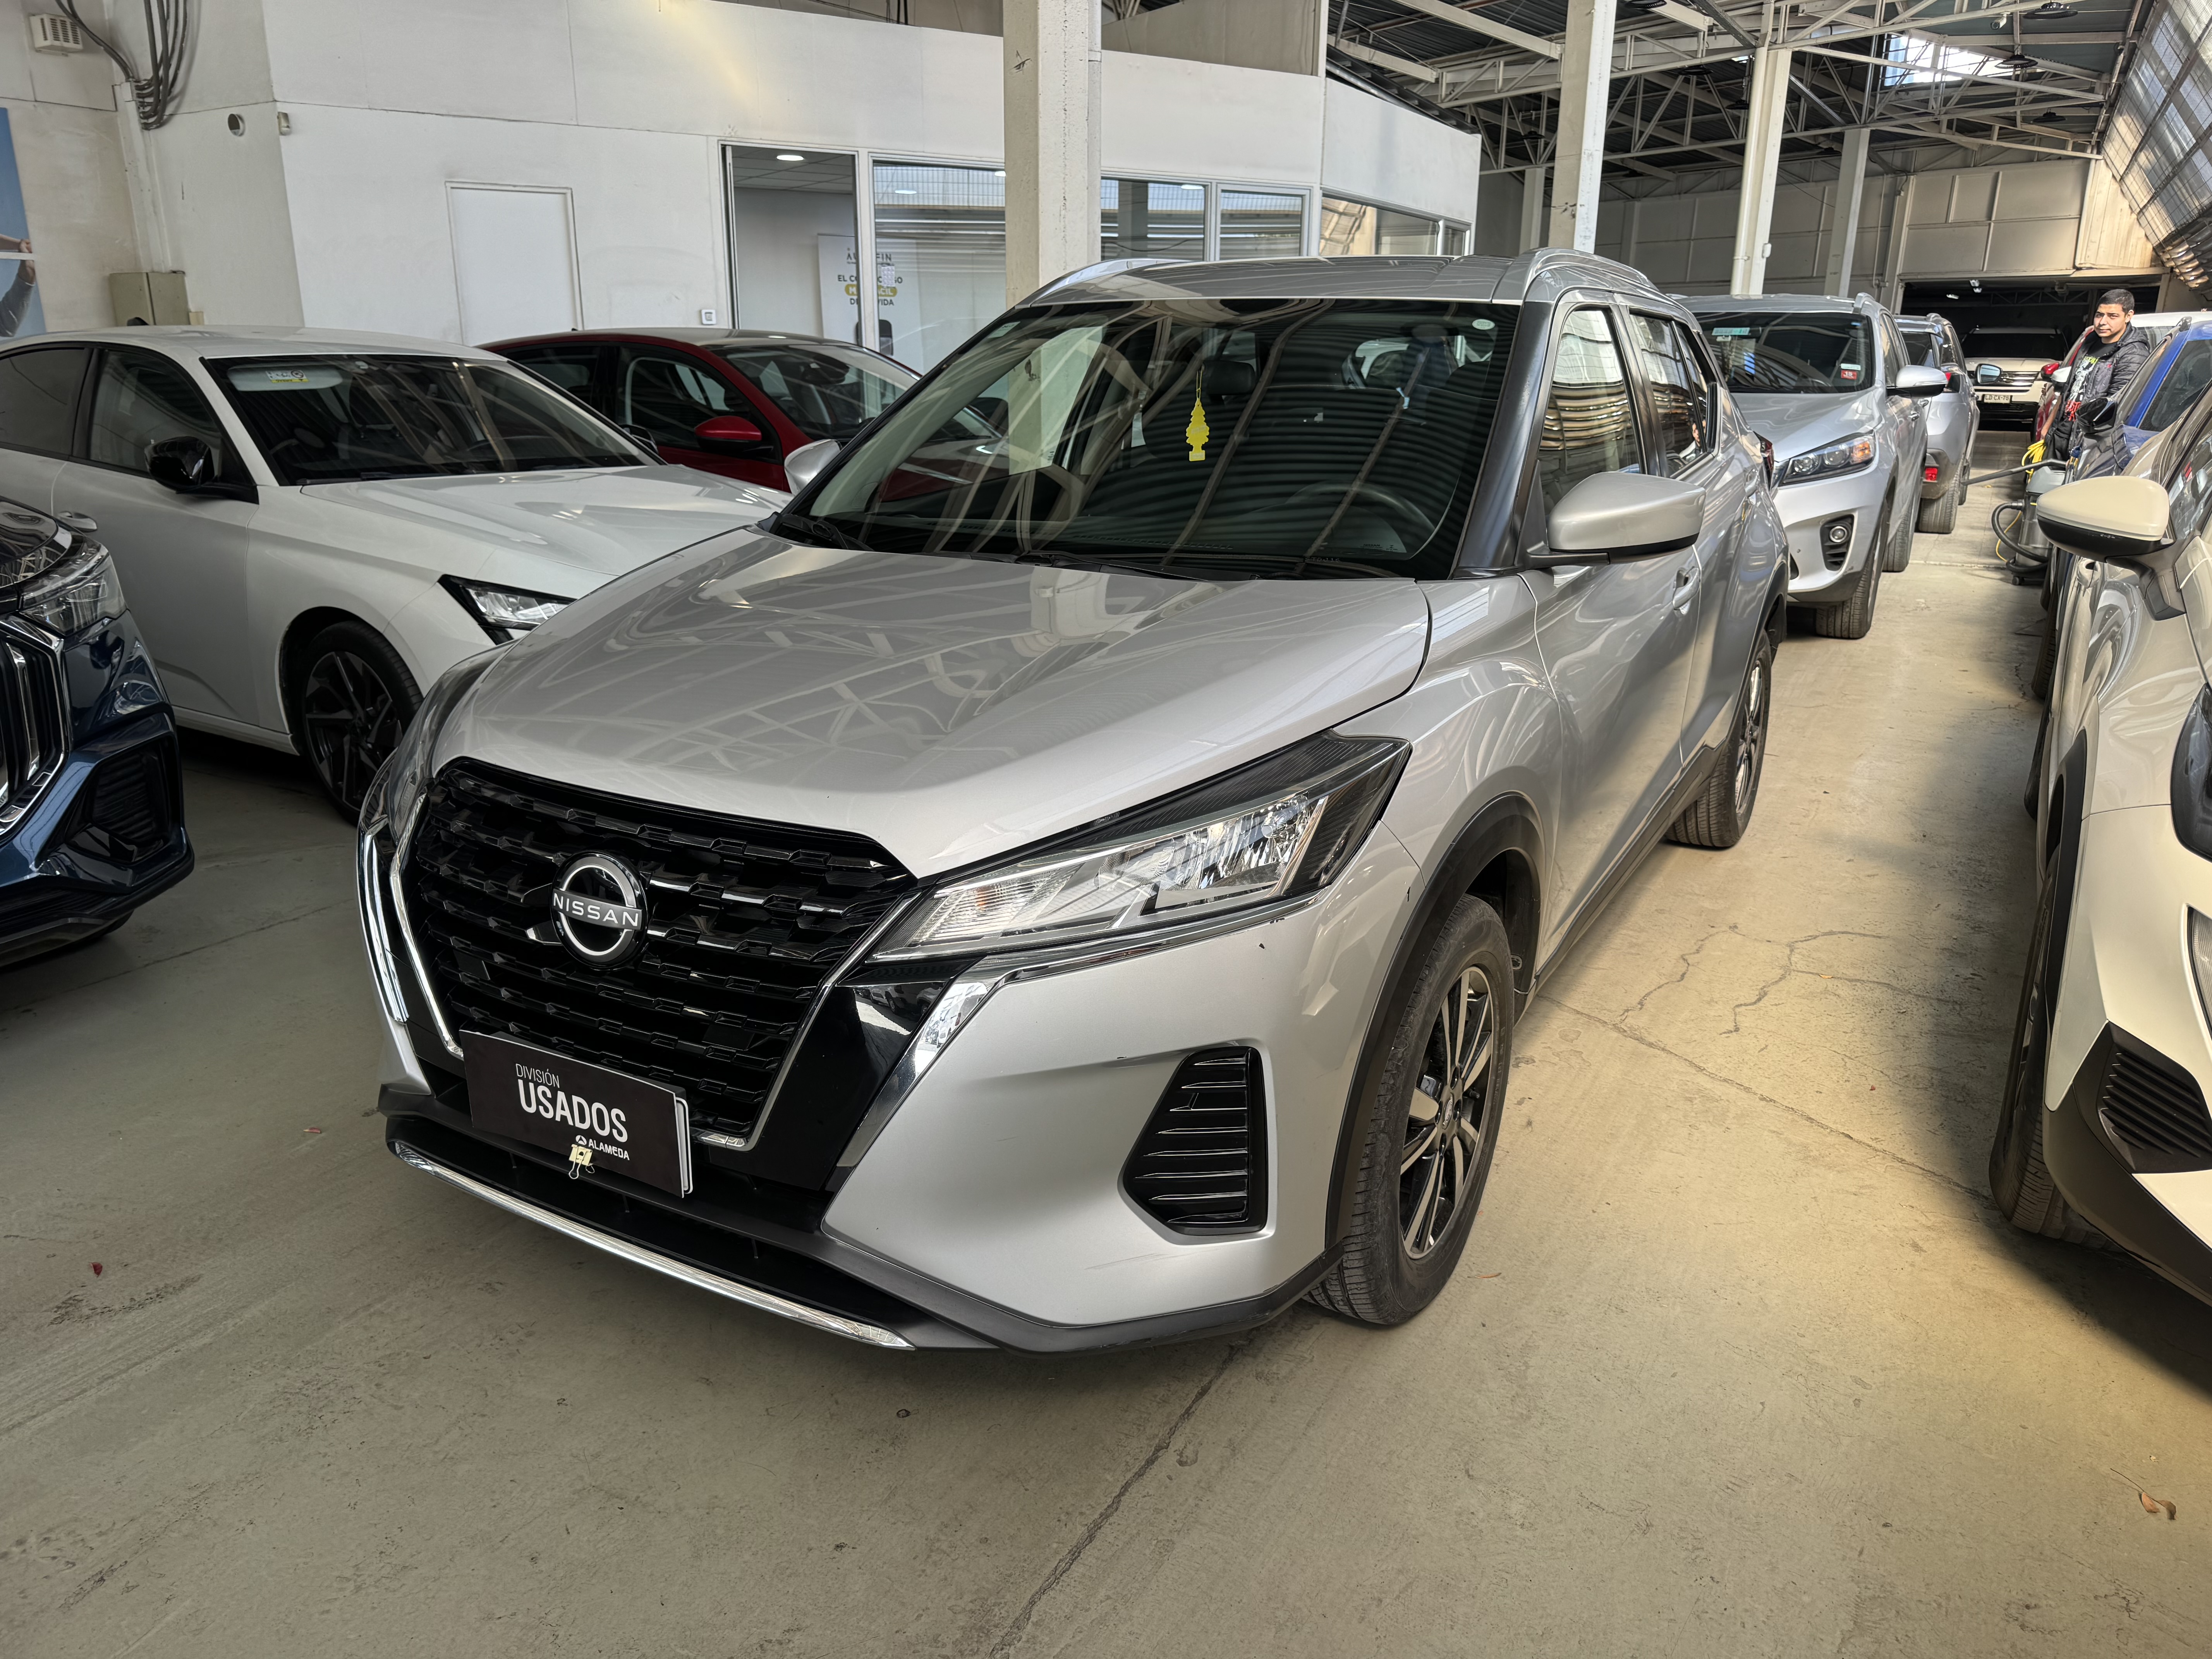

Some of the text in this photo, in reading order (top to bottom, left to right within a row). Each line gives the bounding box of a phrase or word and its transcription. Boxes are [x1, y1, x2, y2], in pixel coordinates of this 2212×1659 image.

[553, 893, 639, 926] NISSAN
[515, 1063, 560, 1088] DIVISIÓN
[518, 1079, 628, 1143] USADOS
[589, 1139, 630, 1161] ALAMEDA
